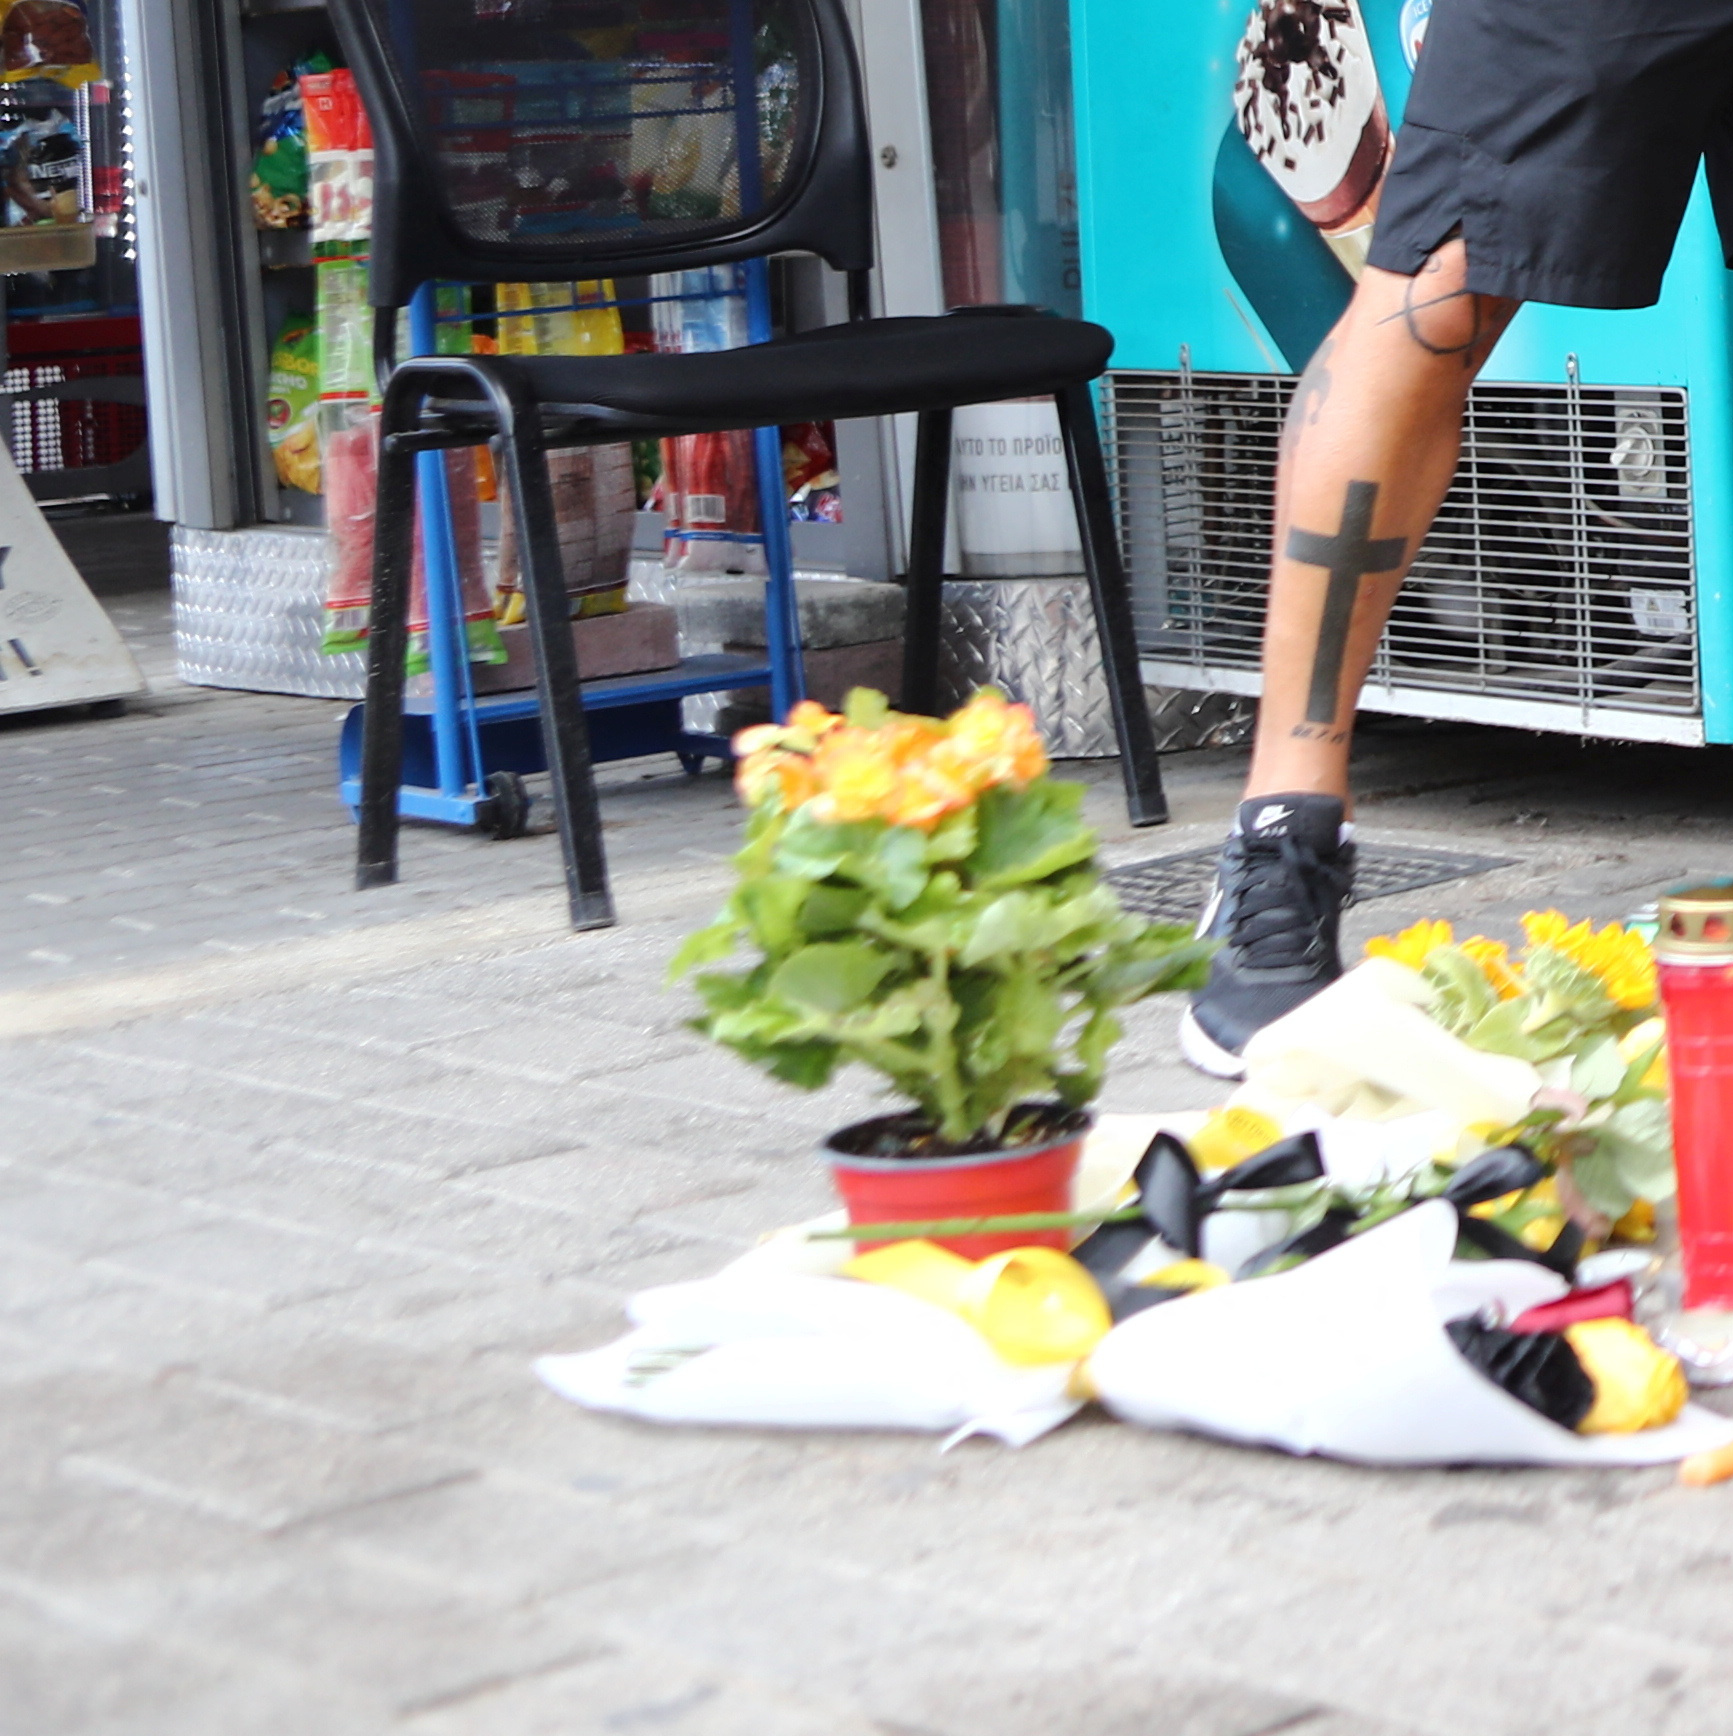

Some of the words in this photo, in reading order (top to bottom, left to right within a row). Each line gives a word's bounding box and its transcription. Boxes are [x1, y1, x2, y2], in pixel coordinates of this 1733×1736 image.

[988, 438, 1006, 455] ΤΟ
[1013, 433, 1063, 456] ΠΡΟΪΟ
[960, 475, 976, 491] ΗΝ
[982, 474, 1024, 492] ΥΓΕΙΑ
[1031, 473, 1060, 492] ΣΑΣ
